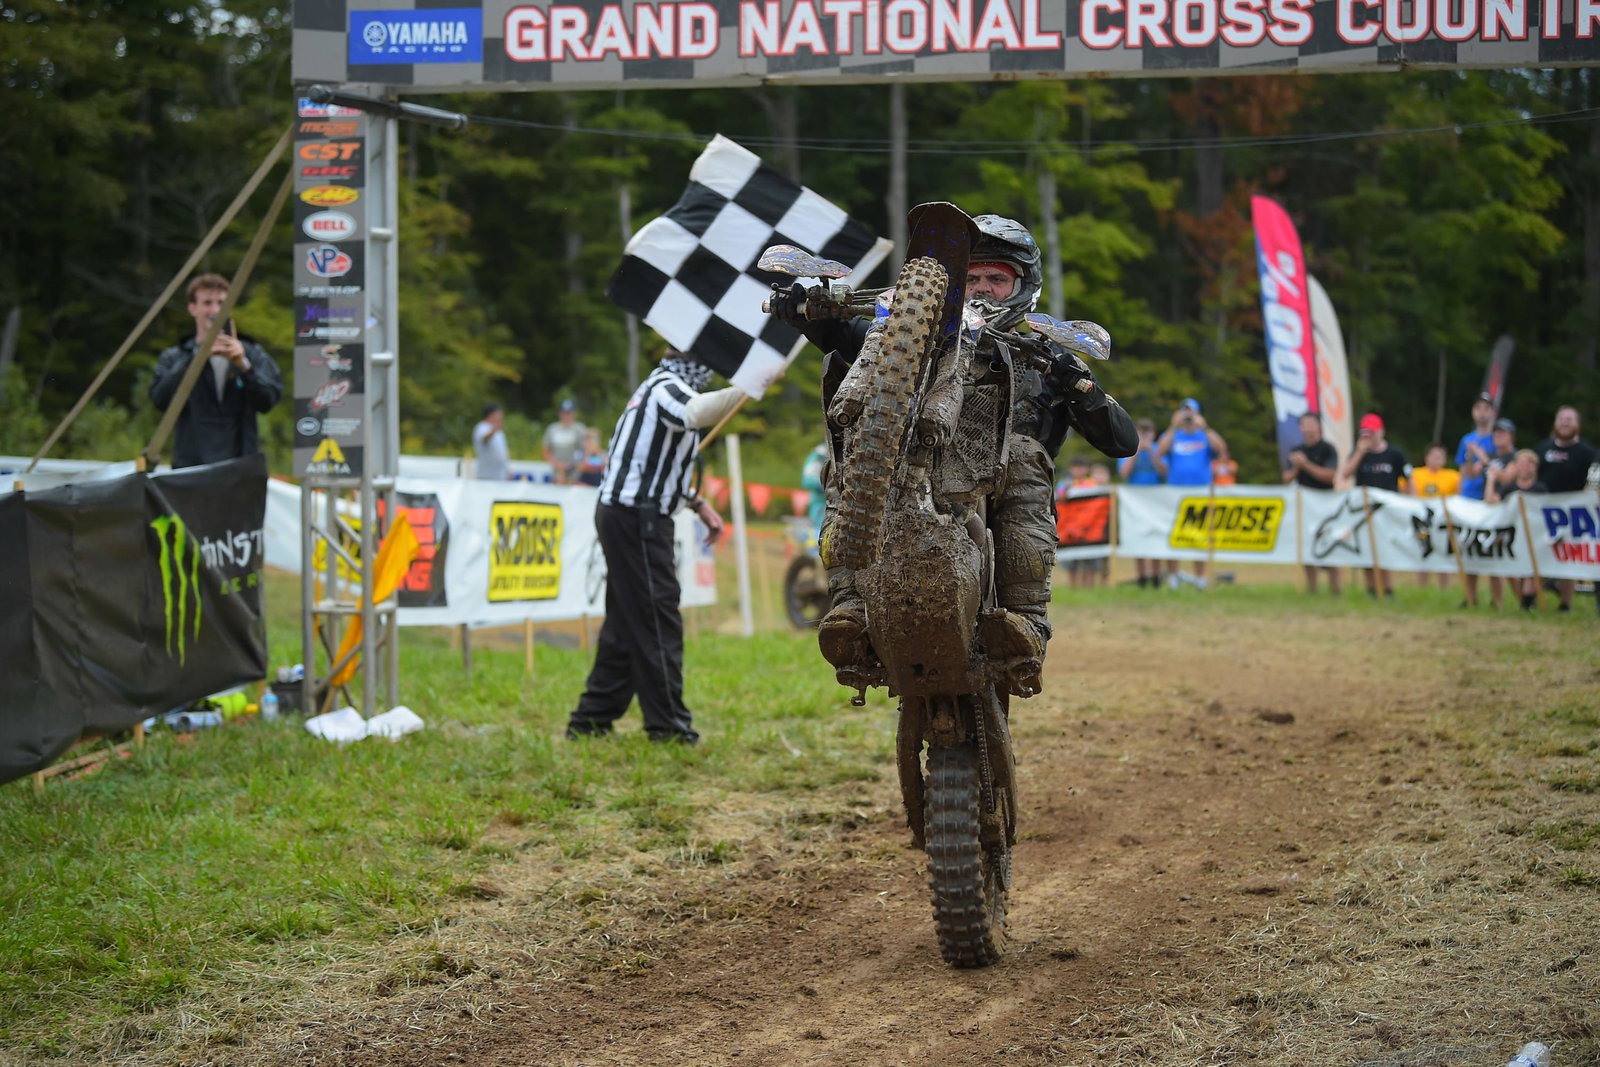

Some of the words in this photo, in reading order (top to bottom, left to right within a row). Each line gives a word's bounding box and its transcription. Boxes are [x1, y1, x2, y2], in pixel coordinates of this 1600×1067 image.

[387, 21, 468, 45] YAMAHA
[505, 4, 718, 61] GRAND
[739, 0, 1062, 57] NATIONAL
[1080, 0, 1314, 49] CROSS
[299, 142, 361, 160] CST
[312, 220, 347, 231] BELL
[310, 247, 337, 273] VP
[1183, 506, 1276, 532] MOOSE
[1541, 507, 1600, 537] PA
